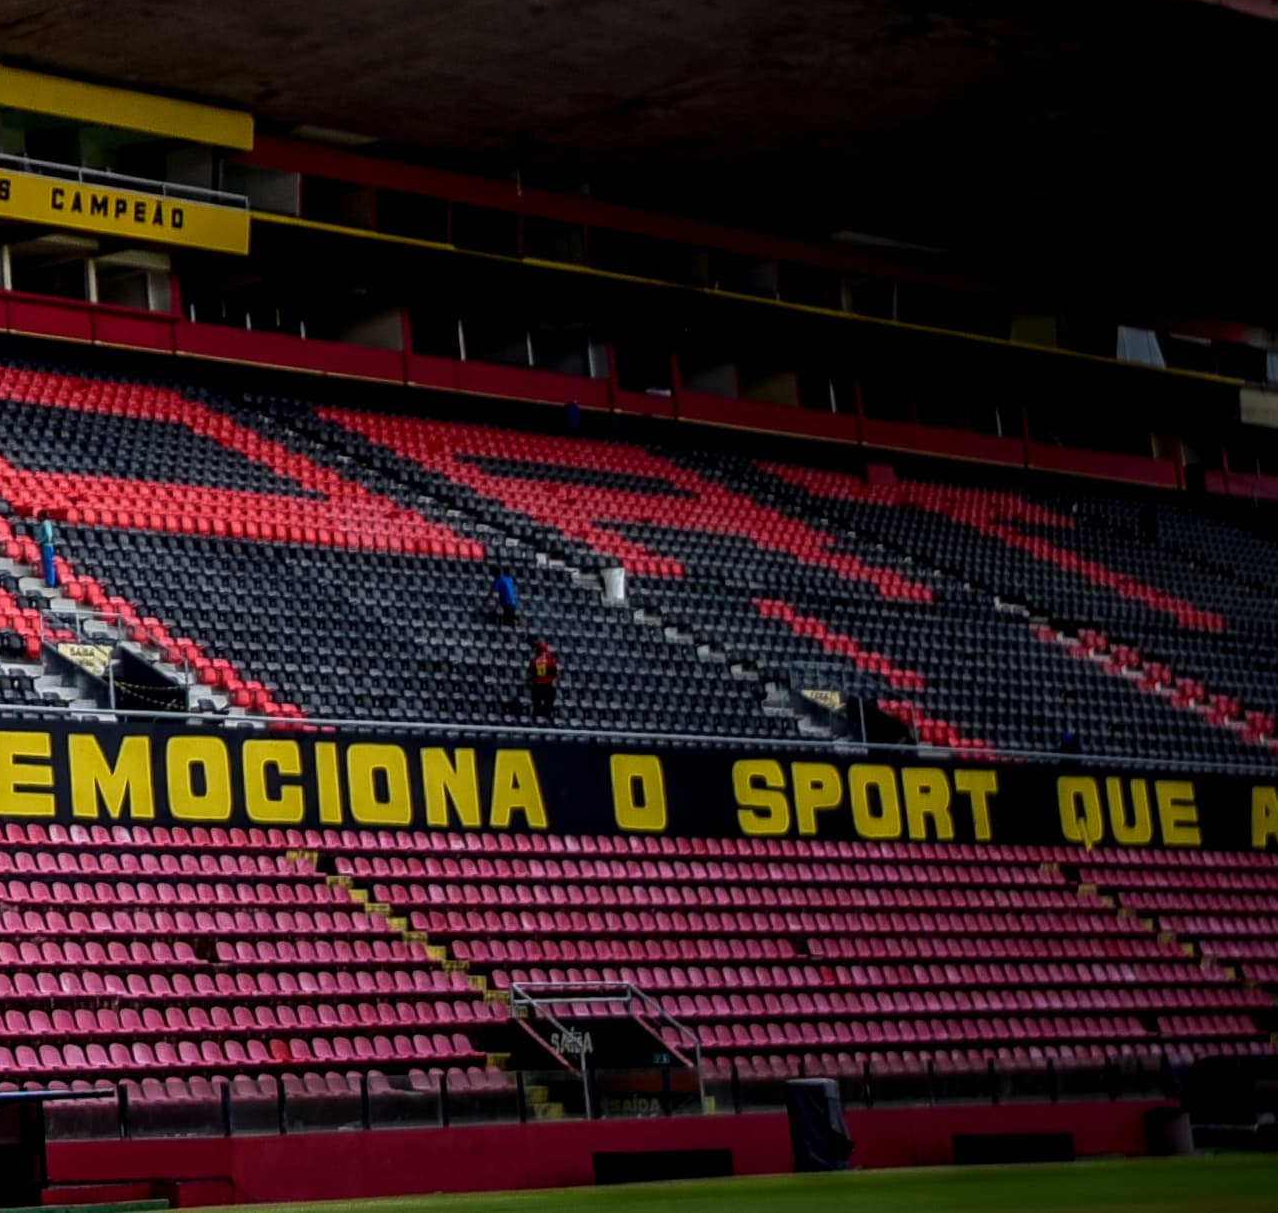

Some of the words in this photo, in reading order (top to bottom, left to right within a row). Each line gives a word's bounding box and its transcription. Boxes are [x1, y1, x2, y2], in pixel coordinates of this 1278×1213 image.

[51, 187, 185, 229] CAMPEÃO
[609, 753, 667, 832] O
[731, 759, 999, 841] SPORT
[1056, 776, 1202, 852] QUE
[550, 1026, 594, 1054] SAA
